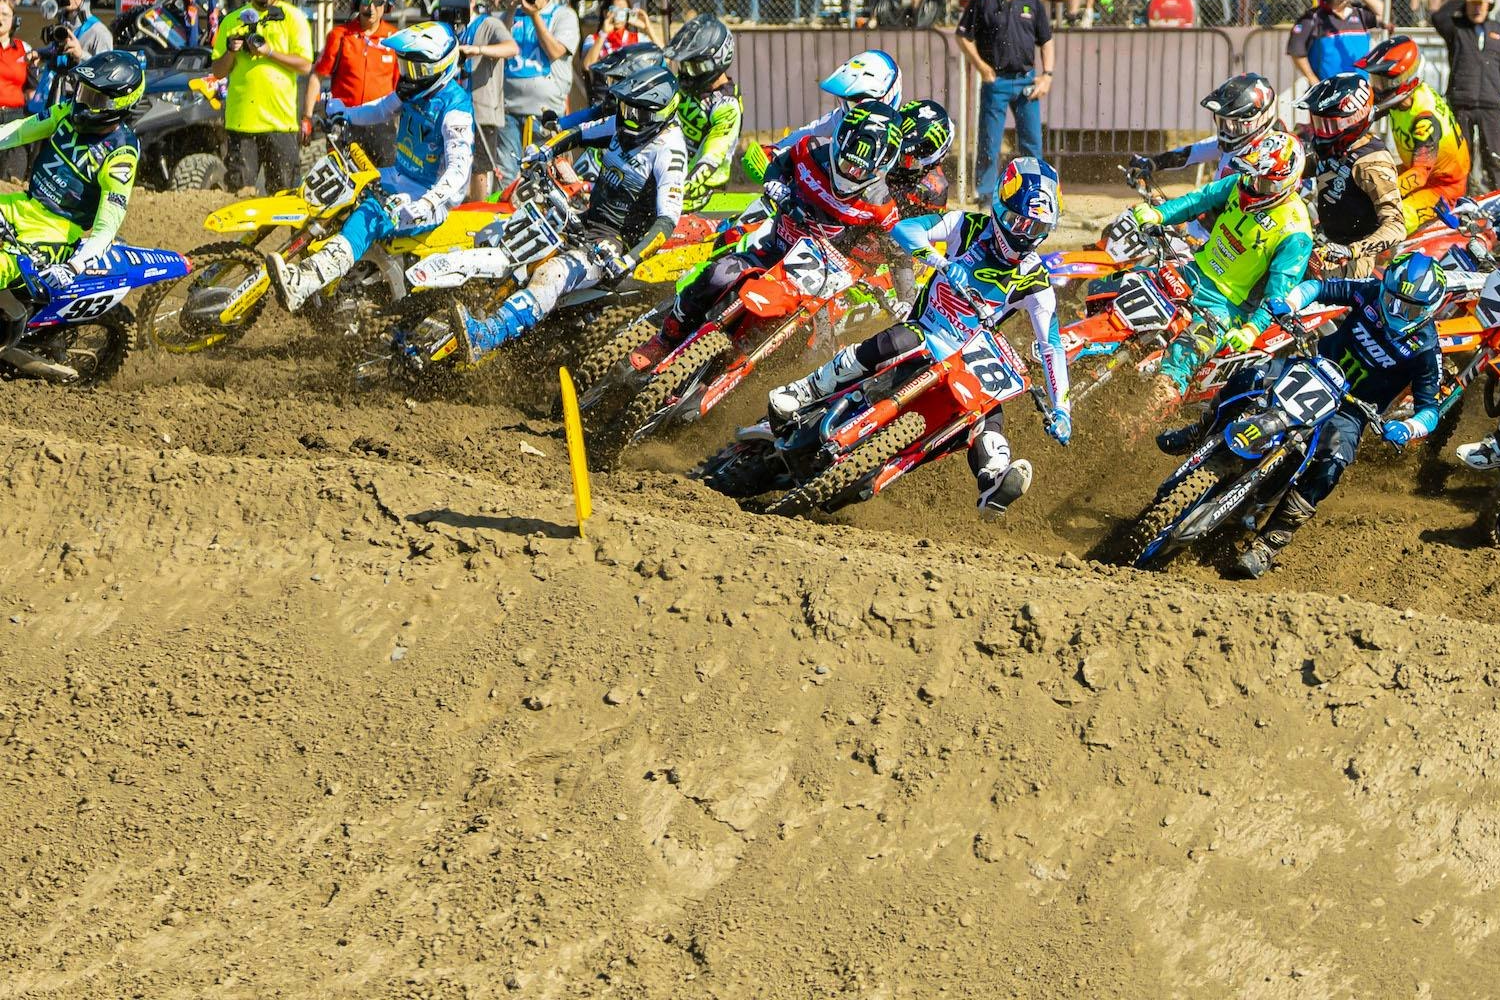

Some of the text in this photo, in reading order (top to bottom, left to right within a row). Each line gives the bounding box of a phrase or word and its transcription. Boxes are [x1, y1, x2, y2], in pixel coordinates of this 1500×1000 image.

[305, 163, 346, 205] 50
[64, 294, 114, 320] 93
[1117, 277, 1168, 327] 107
[1351, 321, 1397, 369] THOR
[962, 346, 1013, 392] 18
[1278, 371, 1334, 421] 14
[1213, 482, 1252, 520] DUNLOP
